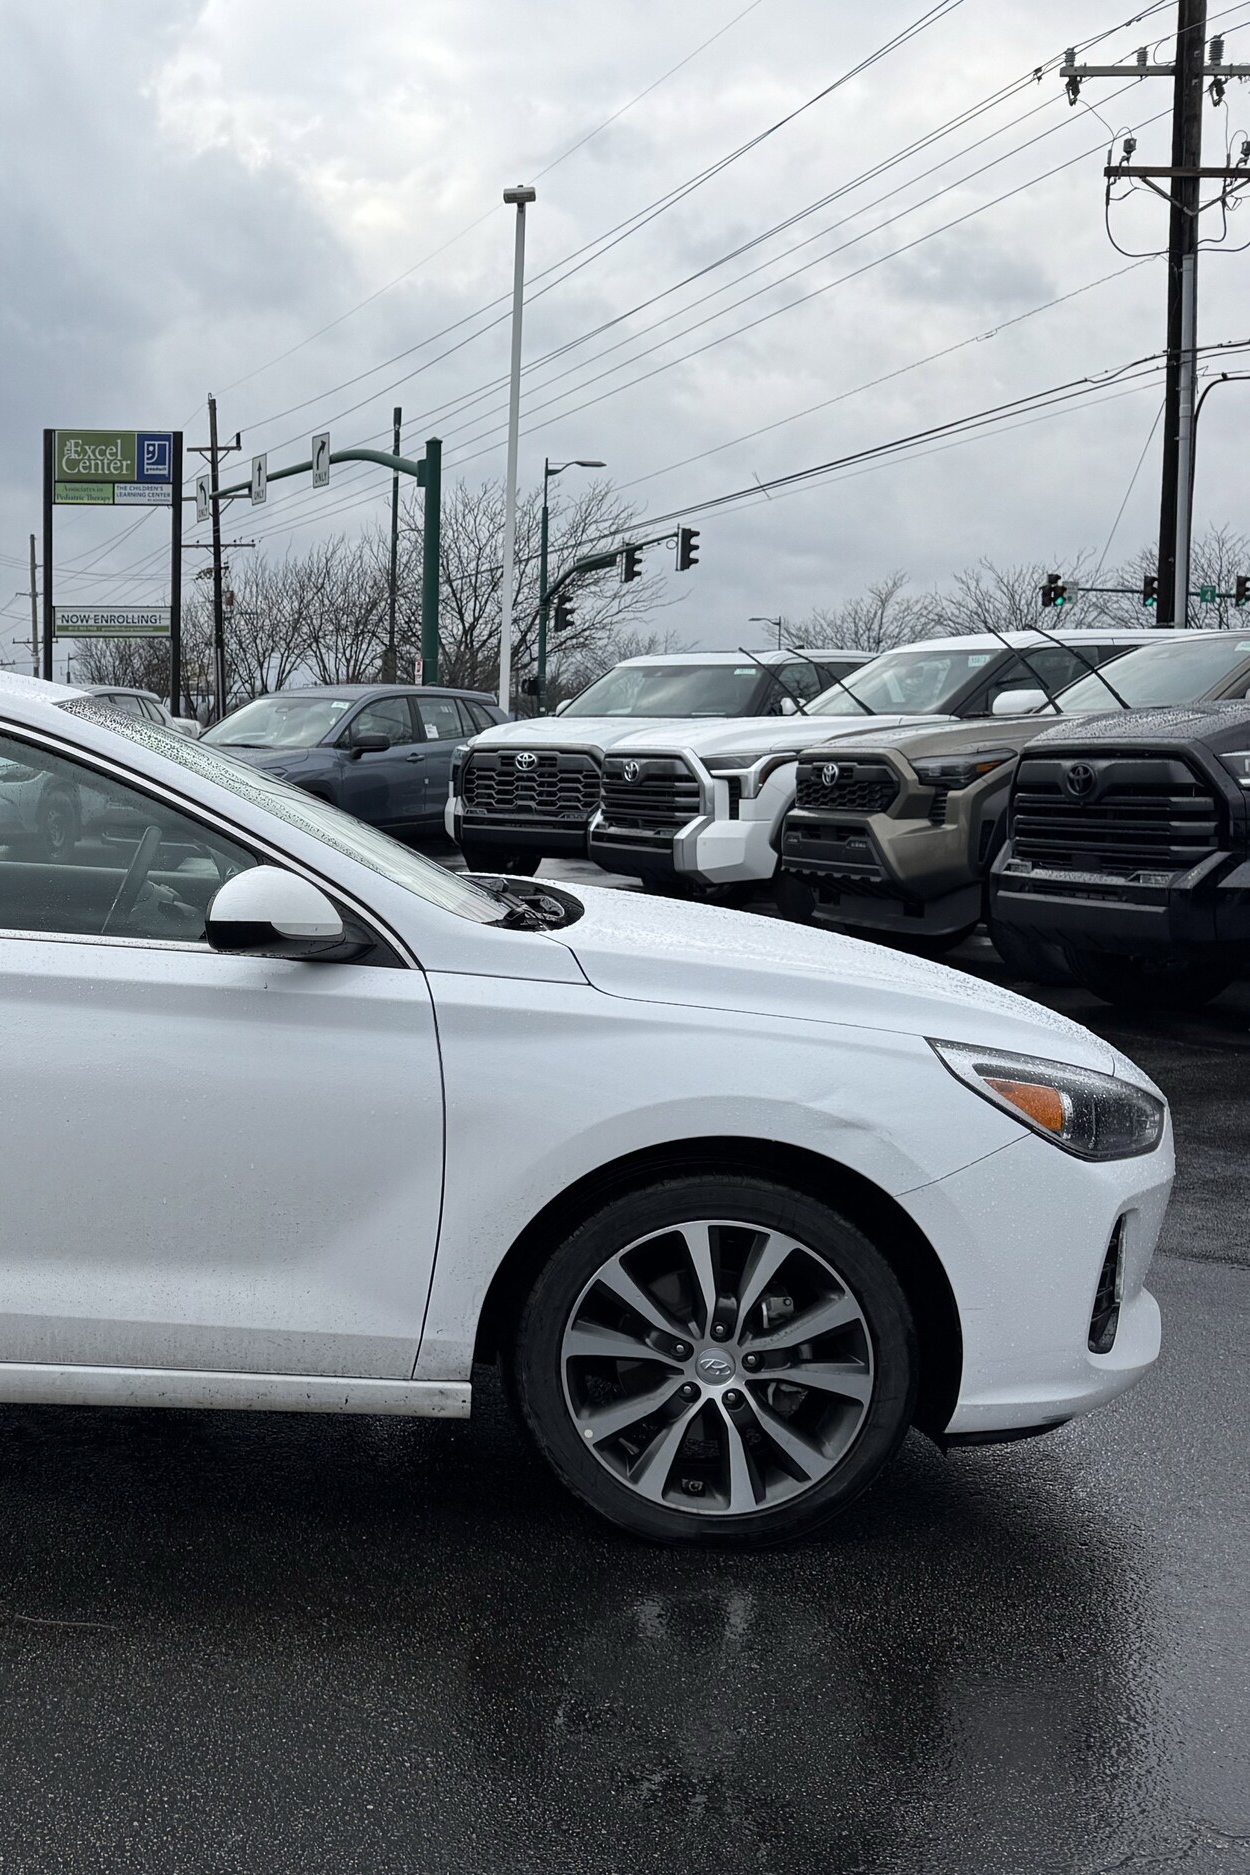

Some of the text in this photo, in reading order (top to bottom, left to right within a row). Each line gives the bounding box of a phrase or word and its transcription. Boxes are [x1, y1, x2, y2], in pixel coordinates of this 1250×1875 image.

[69, 438, 123, 460] Excel
[61, 453, 132, 475] Center
[315, 471, 327, 484] ONLY
[61, 614, 162, 625] NOW ENROLLING!
